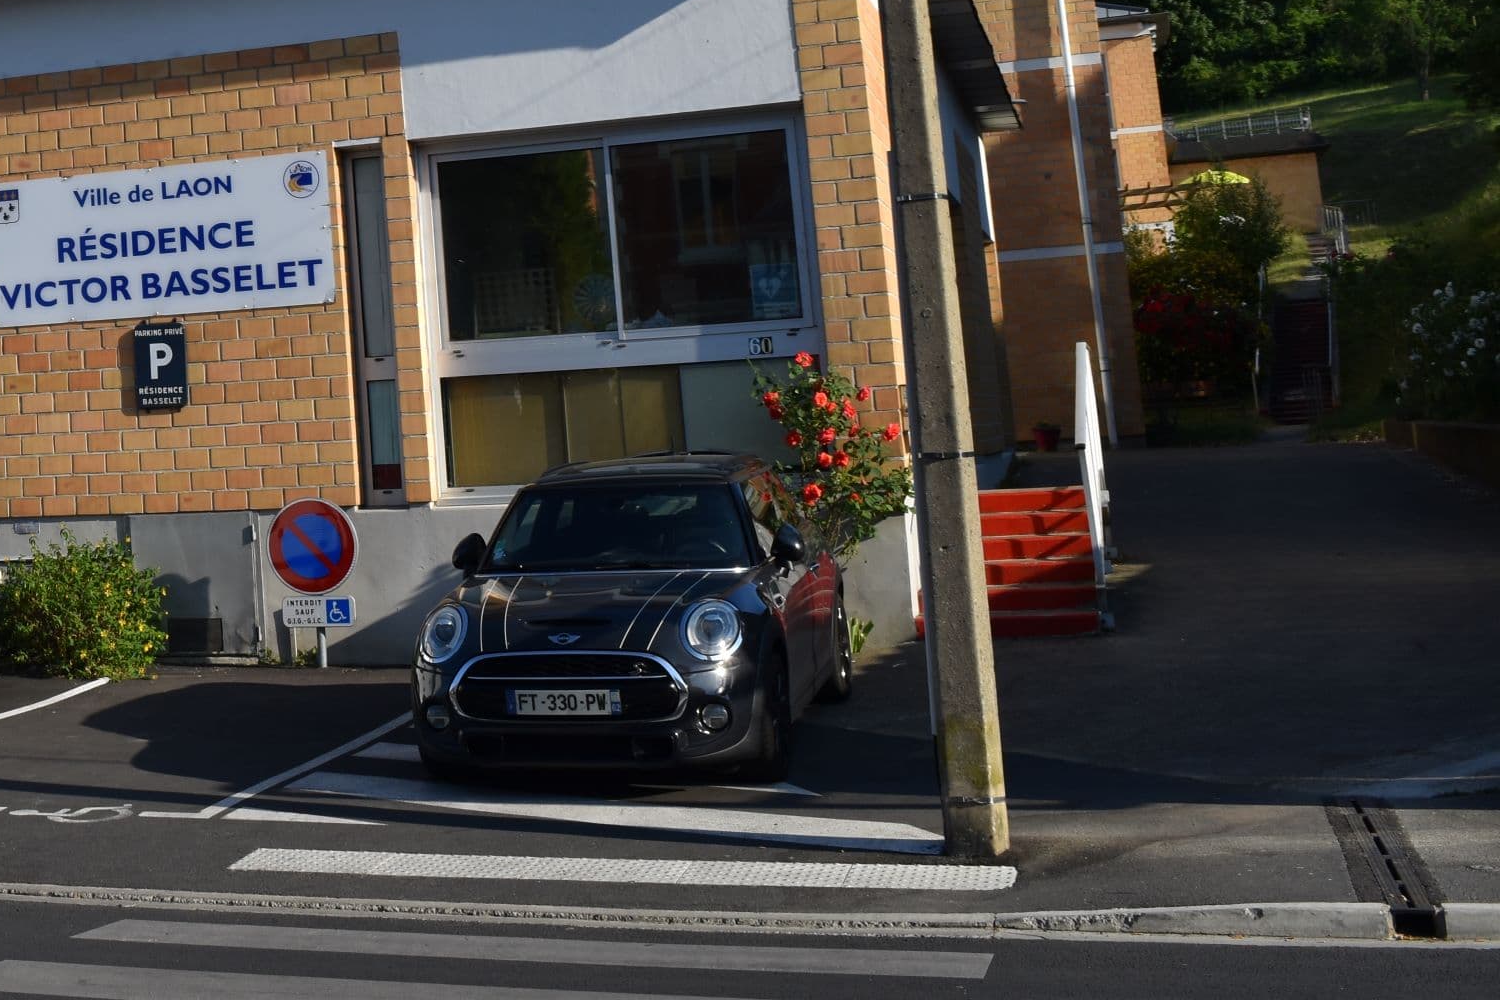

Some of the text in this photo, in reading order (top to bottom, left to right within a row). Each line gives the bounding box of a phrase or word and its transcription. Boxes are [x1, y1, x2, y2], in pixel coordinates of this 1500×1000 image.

[73, 175, 232, 208] Ville de LAON
[57, 220, 255, 263] RÉSIDENCE
[0, 259, 323, 310] VICTOR BASSELET
[134, 329, 162, 337] PARKING
[750, 338, 772, 355] 60
[149, 342, 173, 380] P
[142, 397, 182, 405] BASSELET
[518, 693, 606, 711] FT-330-PW
